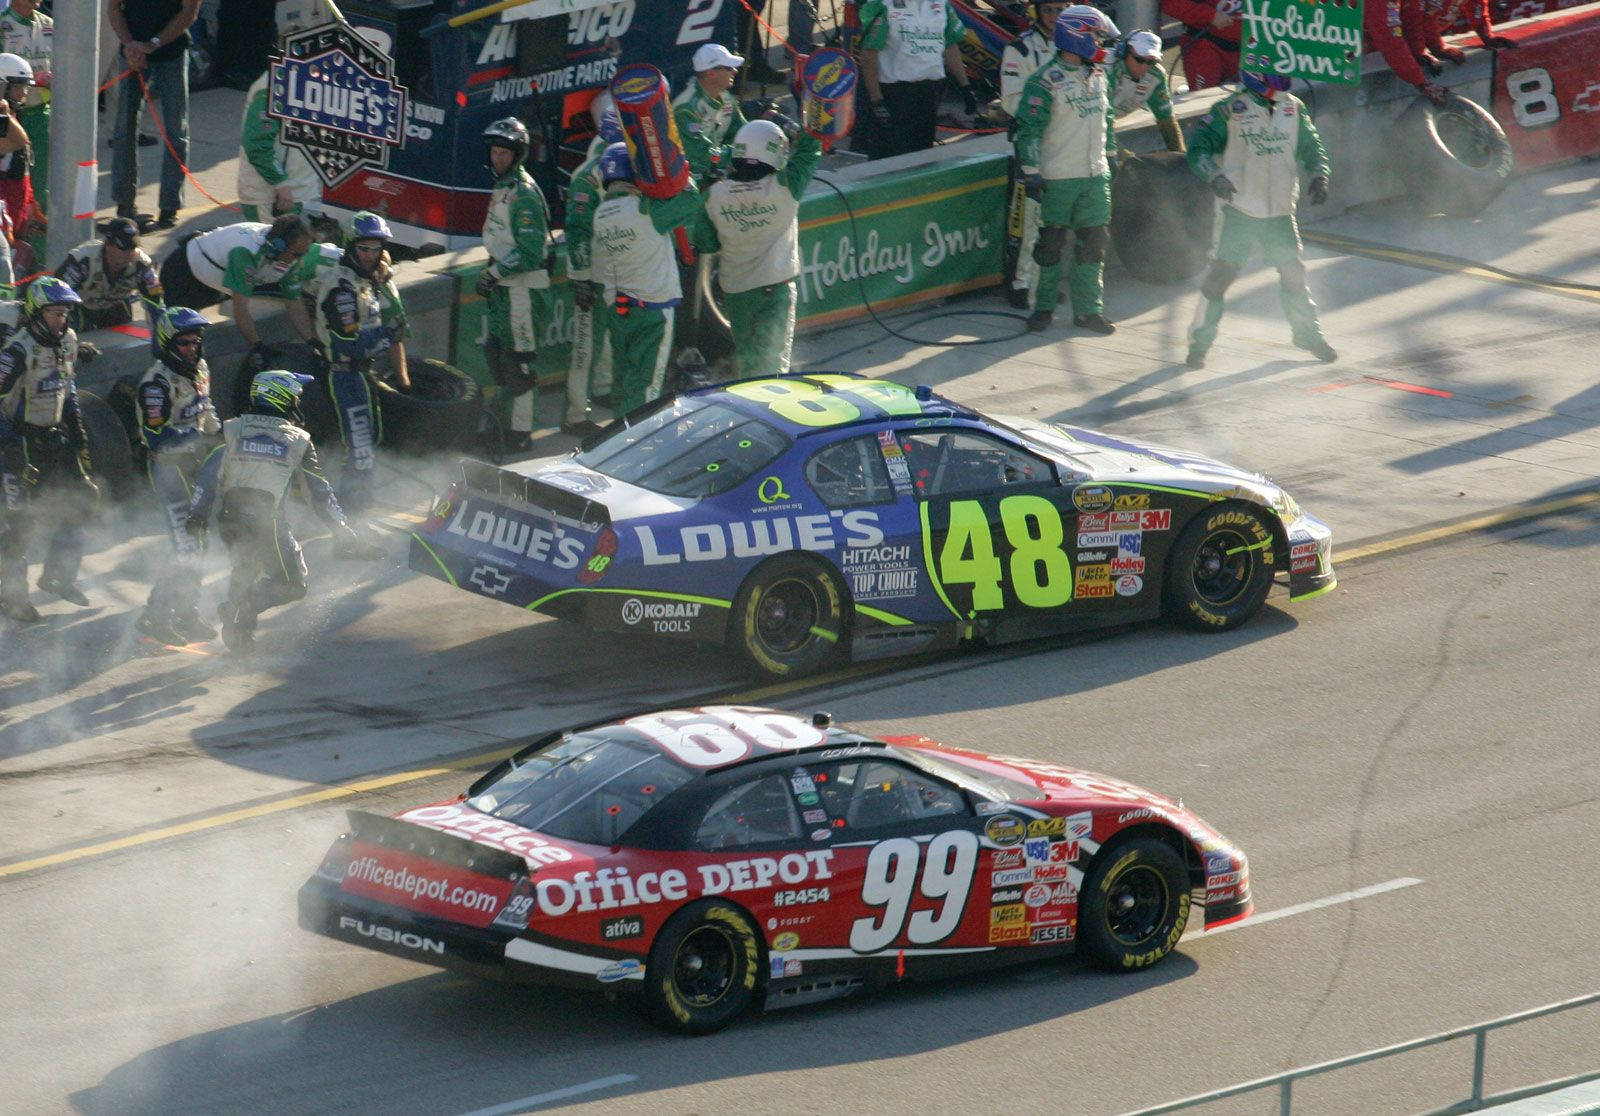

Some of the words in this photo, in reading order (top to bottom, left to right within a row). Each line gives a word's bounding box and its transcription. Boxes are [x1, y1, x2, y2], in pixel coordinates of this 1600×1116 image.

[1241, 0, 1362, 57] Holiday
[1273, 40, 1340, 76] Inn
[575, 57, 618, 86] PARTS
[287, 68, 384, 126] LOWE'S
[1505, 67, 1561, 127] 8
[719, 201, 779, 222] Holiday
[738, 217, 772, 232] Inn
[792, 229, 915, 304] Holiday
[921, 221, 989, 268] Inn
[241, 440, 283, 456] LOWE'S
[1141, 511, 1170, 529] 3M
[446, 498, 586, 570] LOWE'S
[633, 509, 885, 567] LOWE'S
[1119, 533, 1140, 554] USG
[842, 545, 910, 565] HITACHI
[940, 494, 1073, 611] 48
[588, 554, 611, 573] 48
[842, 564, 876, 573] POWER
[879, 561, 909, 570] TOOLS
[1111, 558, 1145, 572] Holley
[853, 572, 876, 593] TOP
[878, 570, 918, 591] CHOICE
[1076, 584, 1113, 597] Stant
[644, 604, 701, 618] KOBALT
[653, 620, 691, 633] TOOLS
[1026, 841, 1049, 861] USG
[1051, 841, 1078, 862] 3M
[348, 856, 498, 914] officedepot.com
[536, 866, 688, 916] Office
[697, 850, 835, 897] DEPOT
[849, 829, 981, 955] 99
[506, 894, 533, 915] 99
[773, 887, 831, 907] #2454
[339, 915, 446, 955] FUSION
[1032, 926, 1072, 942] JESEL
